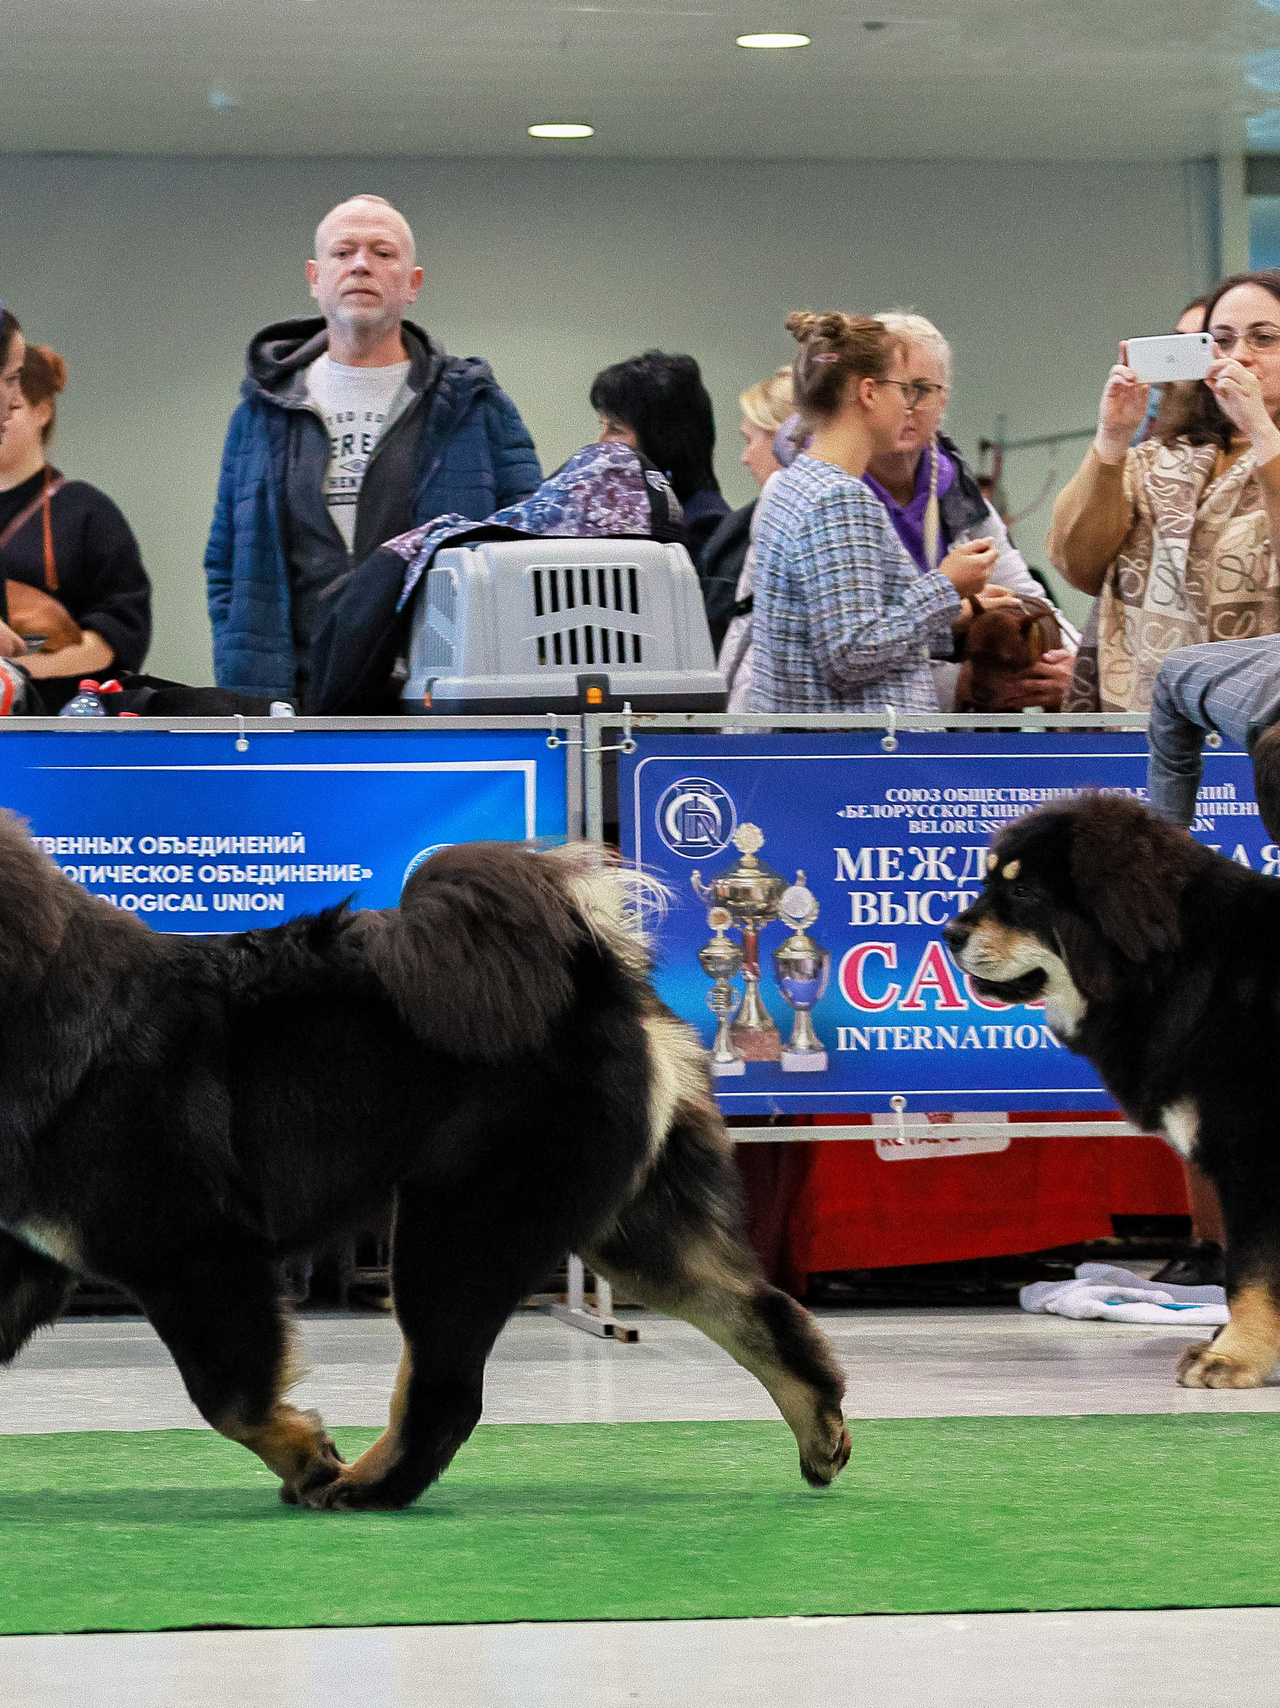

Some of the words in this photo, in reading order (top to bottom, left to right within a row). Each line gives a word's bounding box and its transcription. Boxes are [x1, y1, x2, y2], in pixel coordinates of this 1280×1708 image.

[885, 788, 942, 803] СОЮЗ
[836, 804, 979, 819] «БЕЛОРУССКОЕ
[138, 831, 306, 857] ОБЪЕДИНЕНИЙ
[197, 864, 374, 886] ОБЪЕДИНЕНИЕ»
[212, 892, 285, 912] UNION
